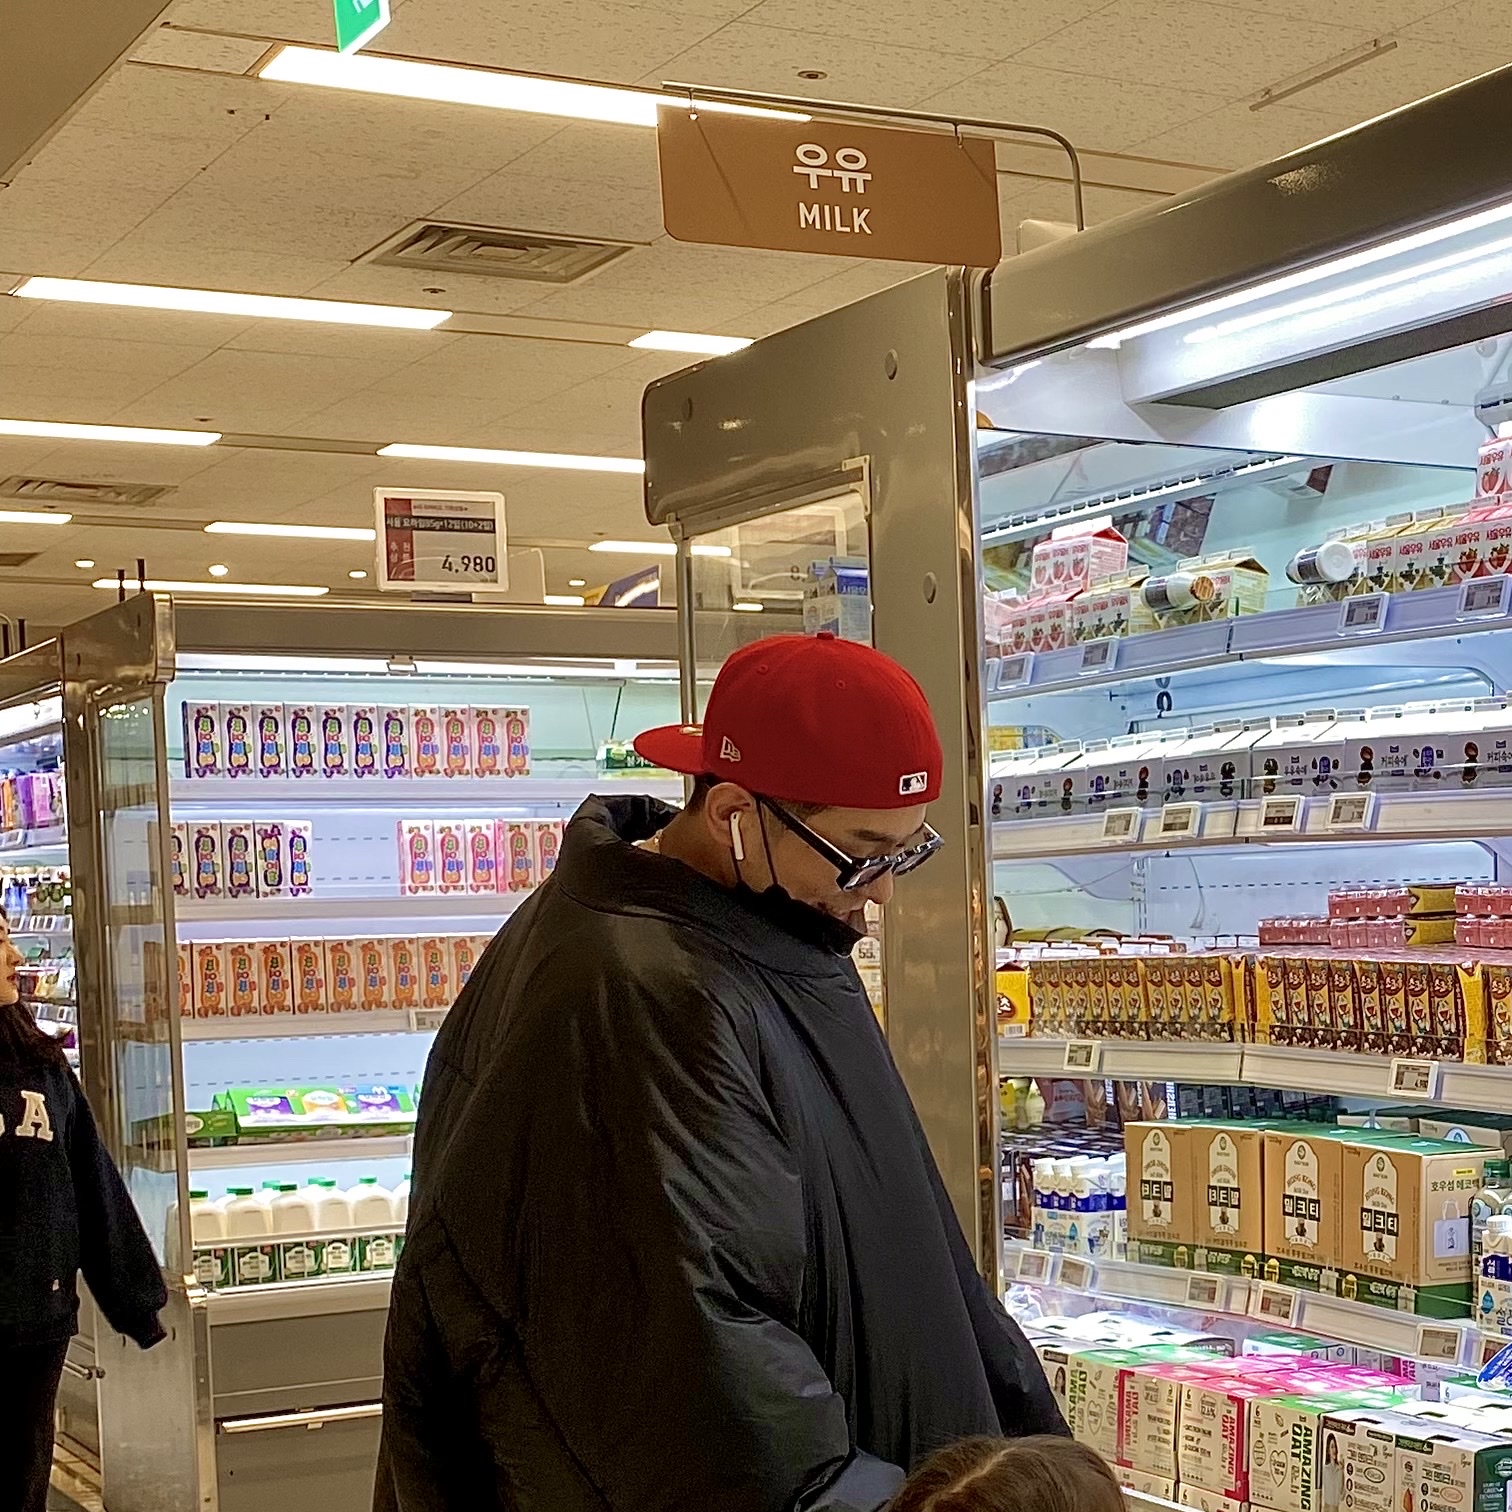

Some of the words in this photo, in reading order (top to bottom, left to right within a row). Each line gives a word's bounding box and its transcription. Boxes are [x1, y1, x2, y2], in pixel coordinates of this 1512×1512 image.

[793, 143, 872, 193] 우유
[799, 202, 872, 234] MILK
[1284, 1196, 1320, 1219] 밀크티
[1362, 1210, 1398, 1232] 밀크티
[1291, 1423, 1300, 1458] OAT
[1301, 1426, 1312, 1510] AMAZING
